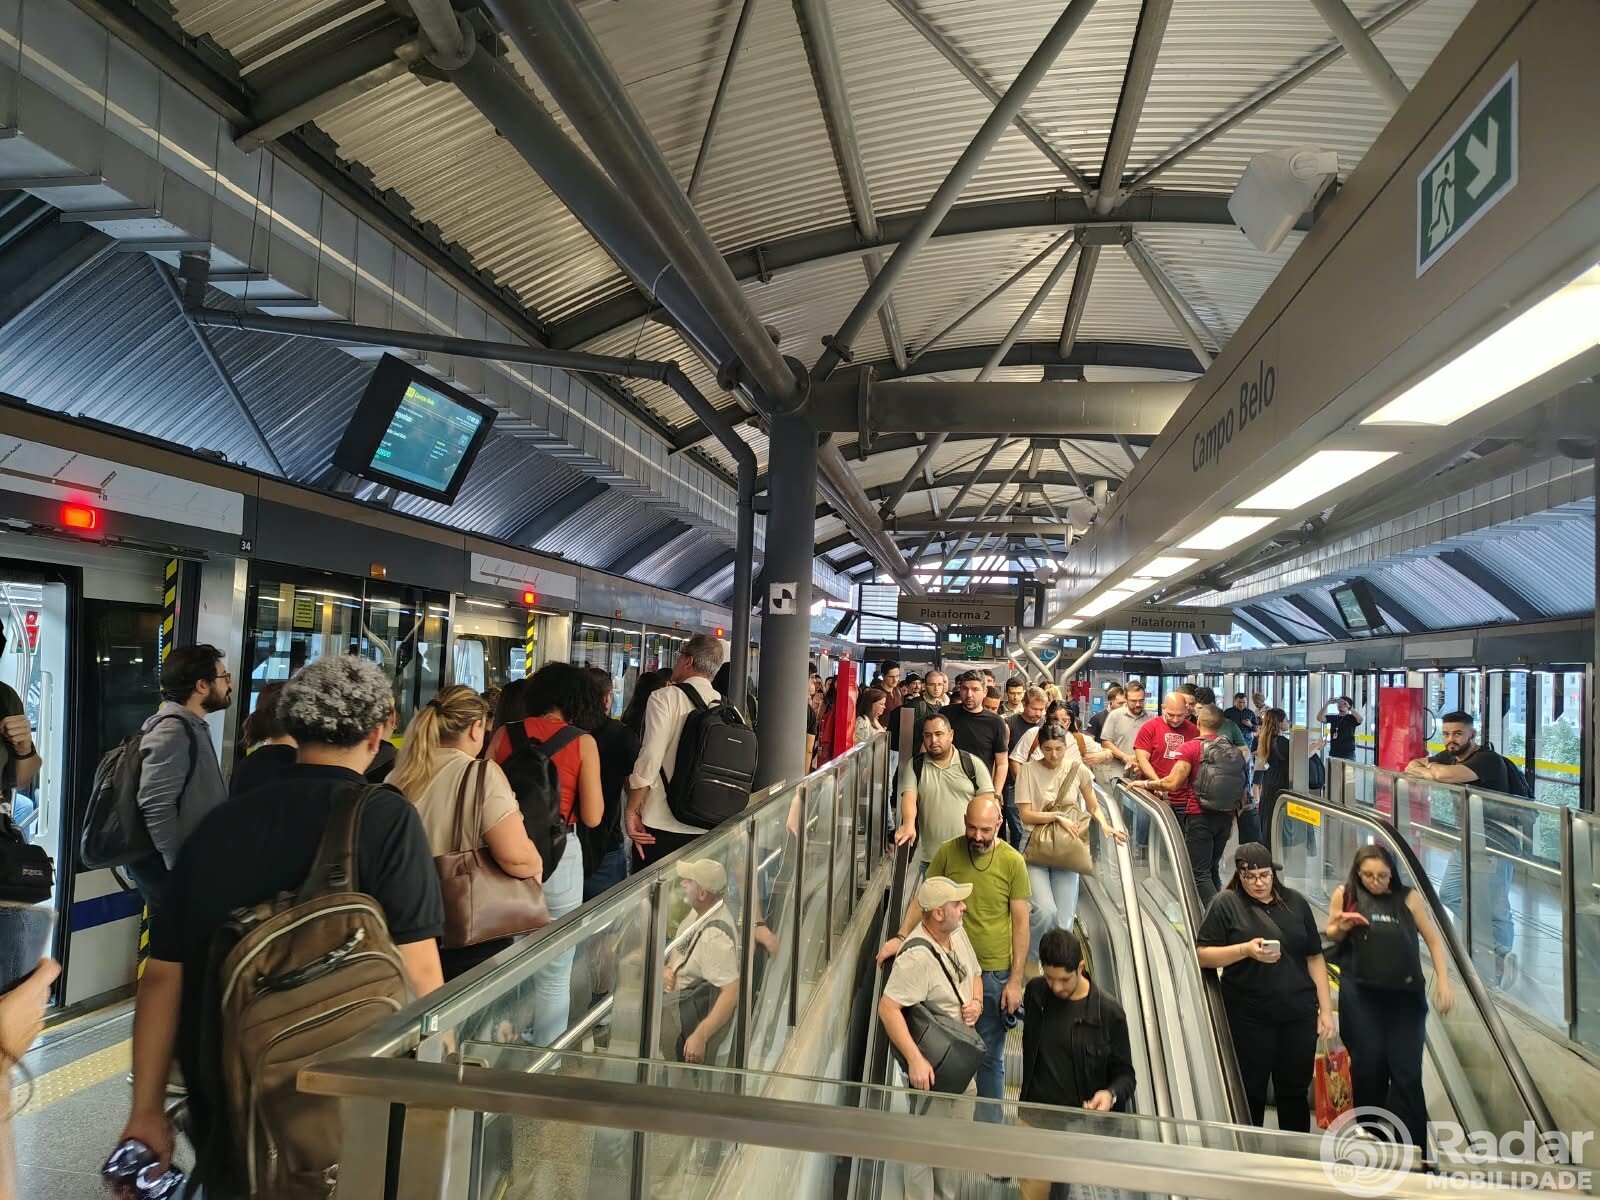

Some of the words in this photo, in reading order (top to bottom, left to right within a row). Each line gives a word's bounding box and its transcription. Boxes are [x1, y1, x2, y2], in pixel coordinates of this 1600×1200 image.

[1192, 407, 1235, 472] Campo
[1239, 359, 1275, 432] Belo
[241, 541, 251, 551] 34
[920, 608, 981, 620] Plataforma
[983, 610, 991, 620] 2
[1131, 616, 1196, 629] Plataforma
[1200, 619, 1206, 629] 1
